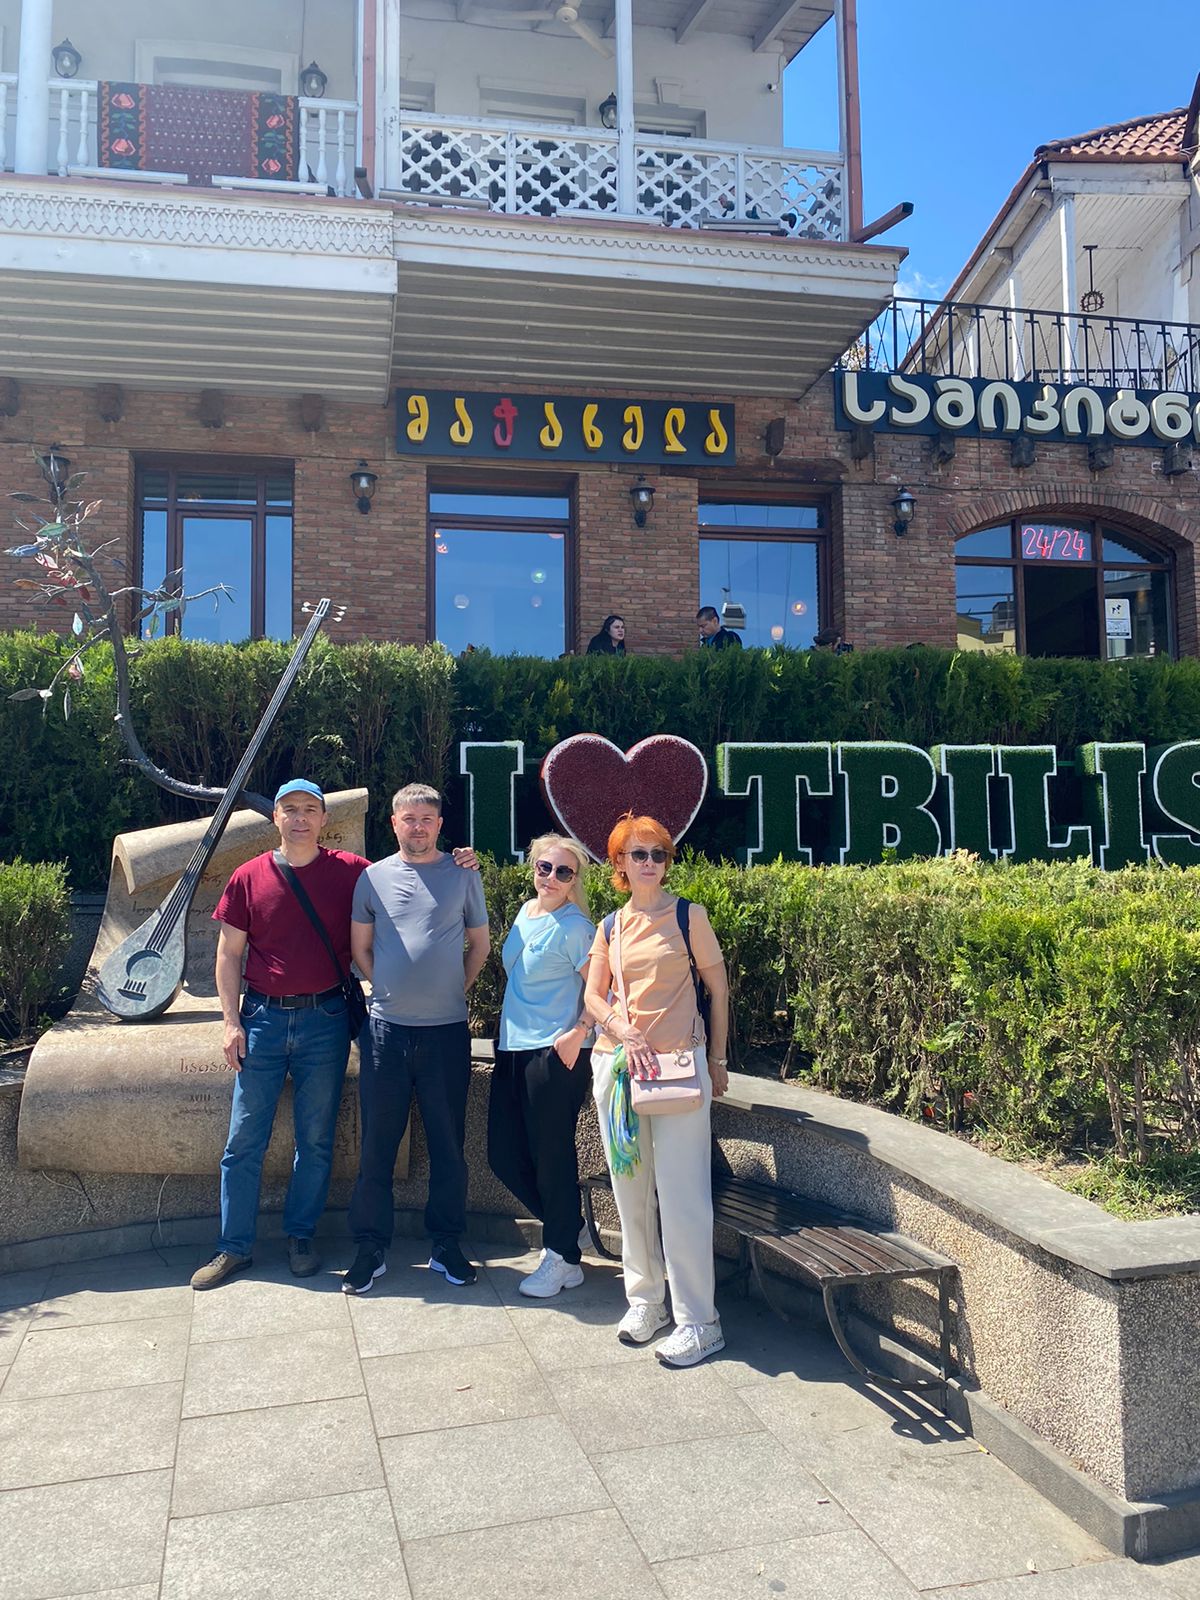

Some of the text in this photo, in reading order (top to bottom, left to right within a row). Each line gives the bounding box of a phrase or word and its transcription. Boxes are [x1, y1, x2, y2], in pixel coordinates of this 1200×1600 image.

[405, 394, 729, 456] მაჭახელა
[842, 371, 1200, 443] სამიკიტნ
[1023, 527, 1086, 559] 24/24
[459, 740, 524, 865] I
